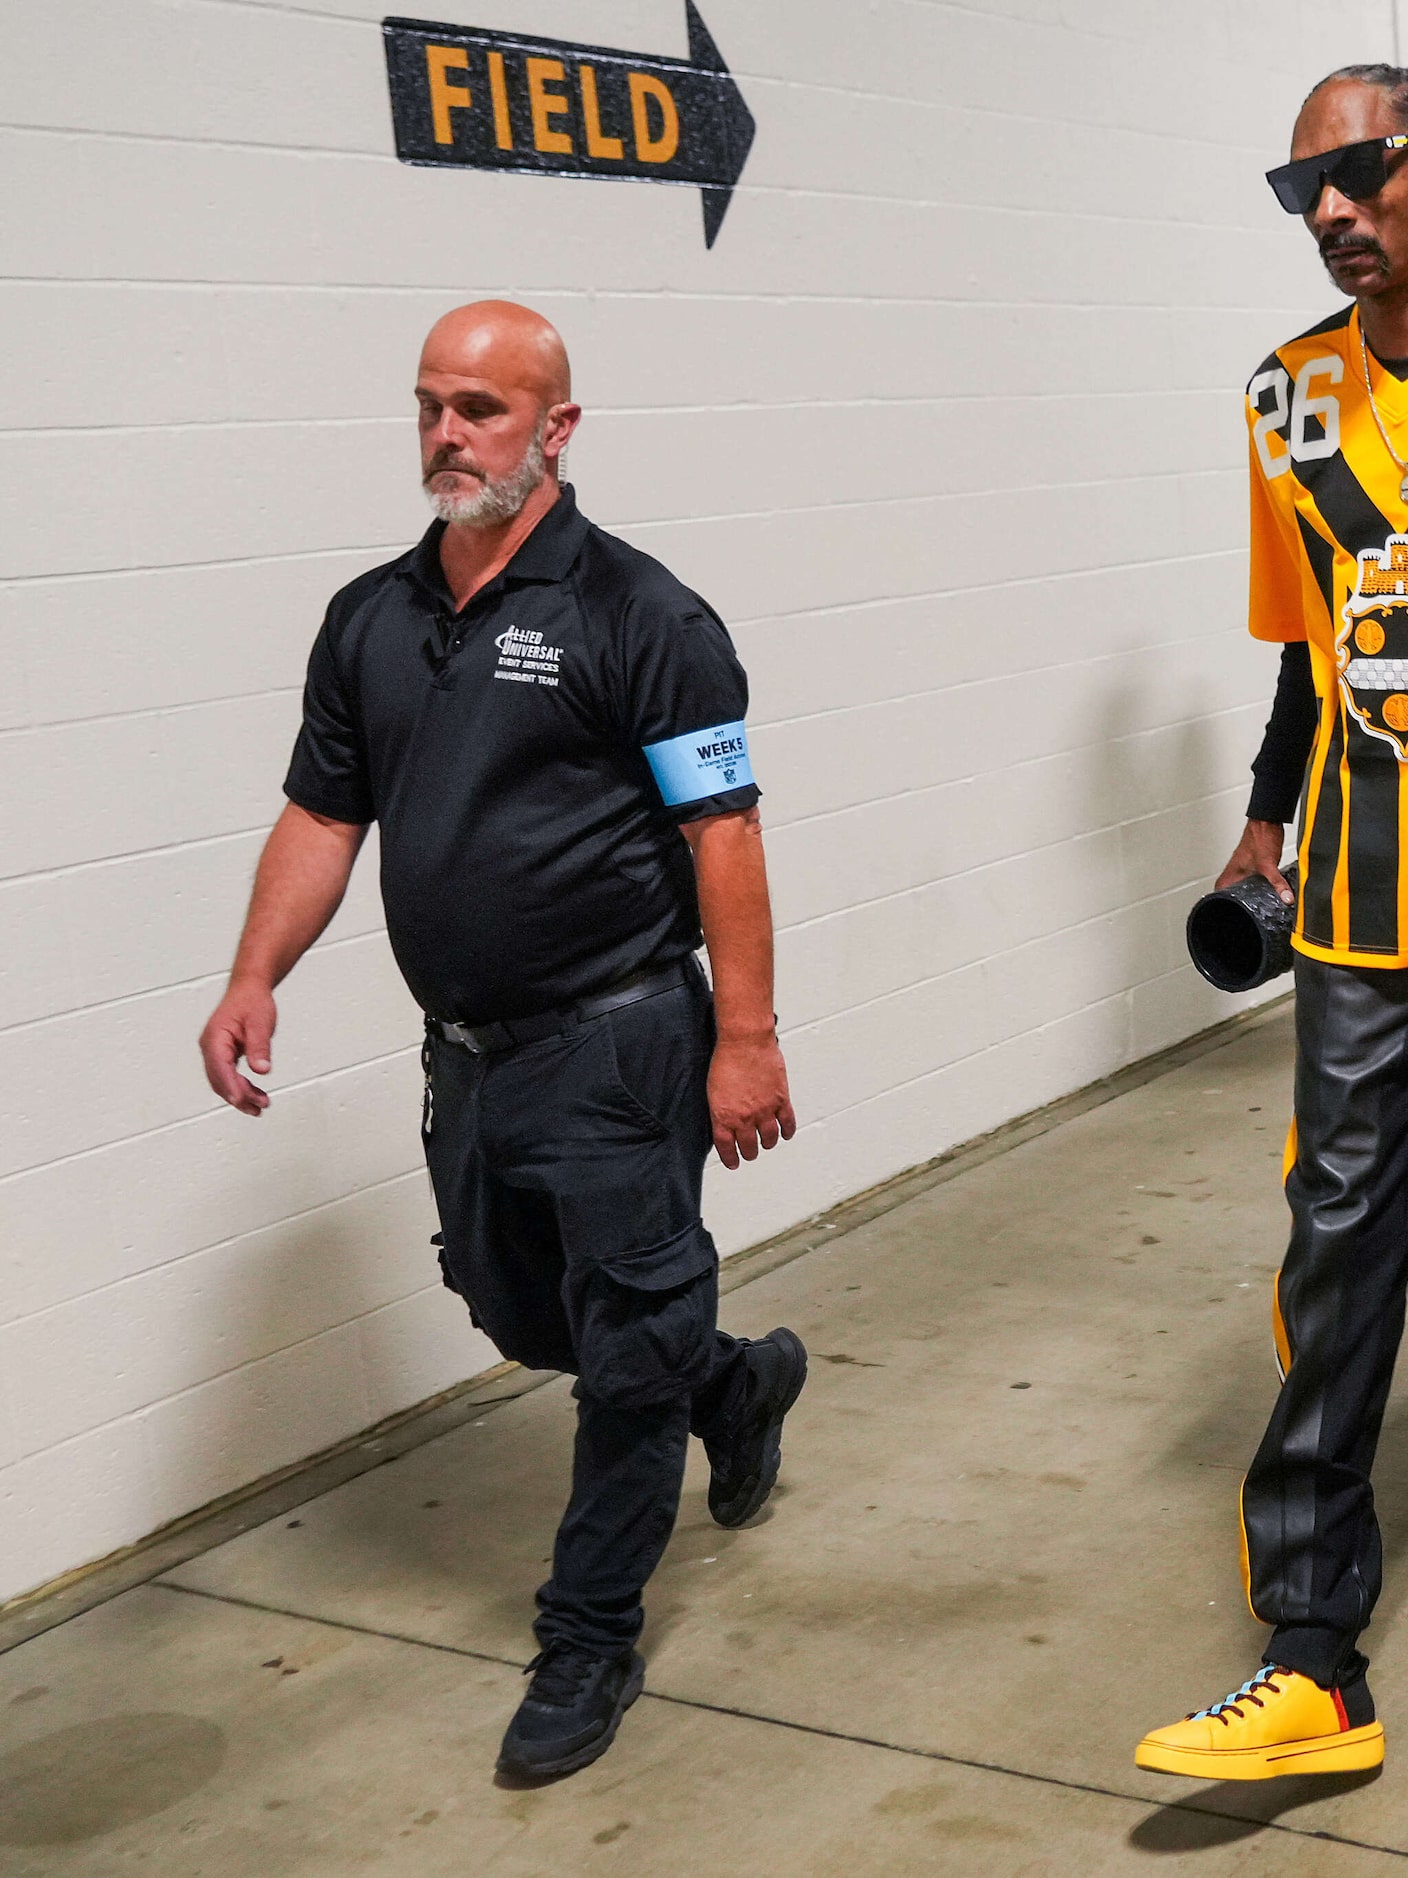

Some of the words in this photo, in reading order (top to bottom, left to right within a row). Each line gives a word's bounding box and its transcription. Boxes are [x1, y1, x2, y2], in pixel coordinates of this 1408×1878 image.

[425, 45, 680, 164] FIELD
[1248, 354, 1345, 480] 26
[505, 625, 544, 645] ALLIED
[502, 641, 561, 662] UNIVERSAL
[498, 656, 521, 668] EVENT
[522, 660, 560, 673] SERVICES
[537, 675, 559, 687] TEAM
[696, 738, 737, 760] WEEK
[736, 737, 743, 750] 5
